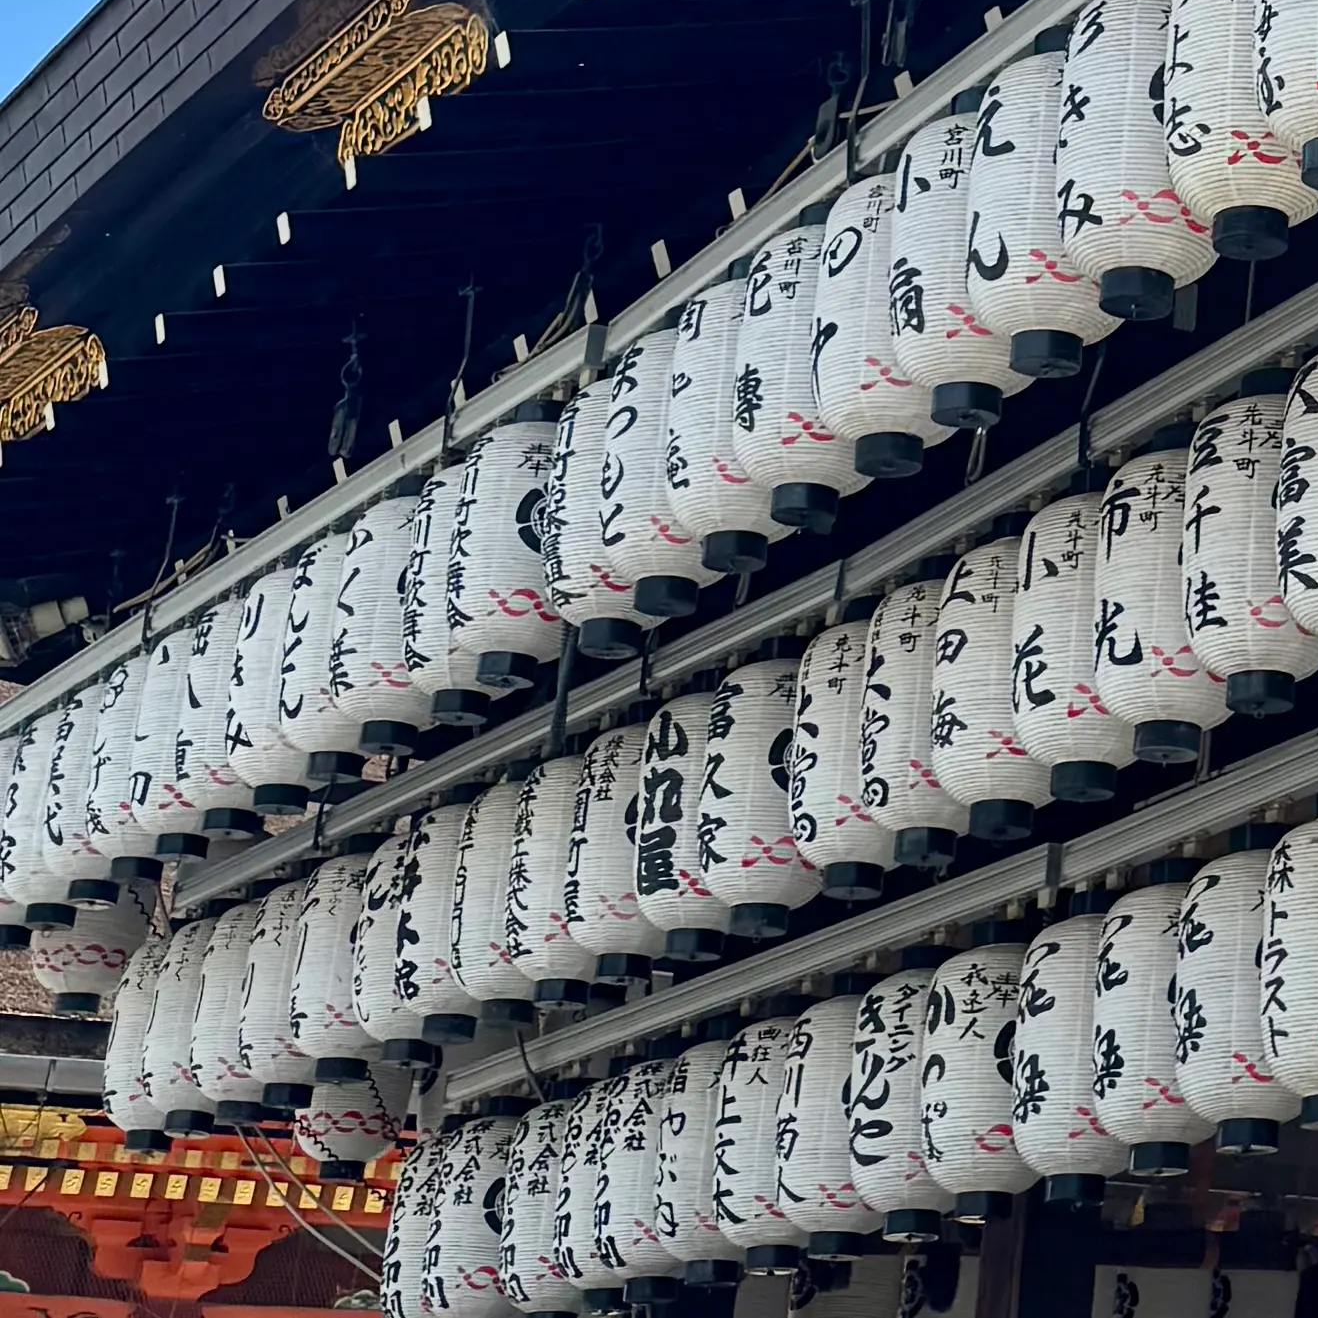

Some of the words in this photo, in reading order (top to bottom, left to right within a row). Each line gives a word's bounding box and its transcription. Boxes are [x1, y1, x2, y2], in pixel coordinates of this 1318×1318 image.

[938, 122, 970, 190] 宮川町
[862, 183, 889, 234] 宮川町
[777, 236, 808, 300] 宮川町
[1232, 403, 1262, 480] 先斗町
[1139, 462, 1166, 532] 先斗町
[1061, 509, 1086, 570] 先斗町
[898, 584, 927, 653] 先斗町
[827, 633, 853, 696] 先斗町
